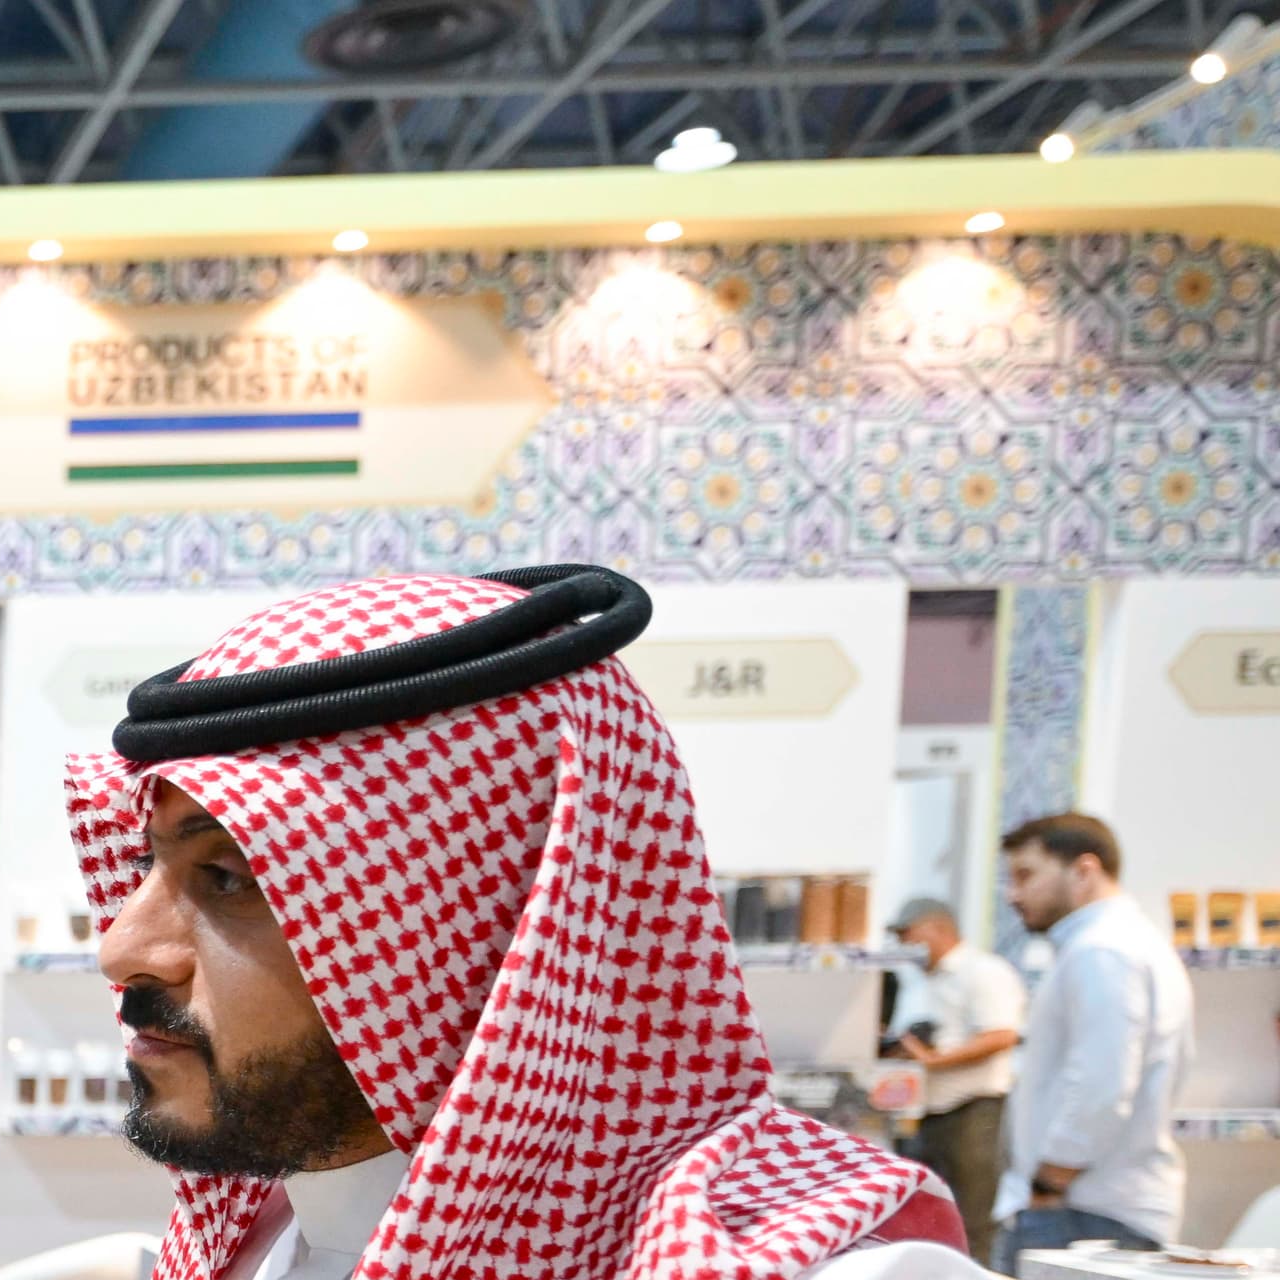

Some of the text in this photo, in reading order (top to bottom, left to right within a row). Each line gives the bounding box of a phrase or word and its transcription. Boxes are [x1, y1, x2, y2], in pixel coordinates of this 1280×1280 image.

[69, 334, 367, 368] PRODUCTS OF
[67, 369, 369, 407] UZBEKISTAN
[688, 660, 766, 698] J&R
